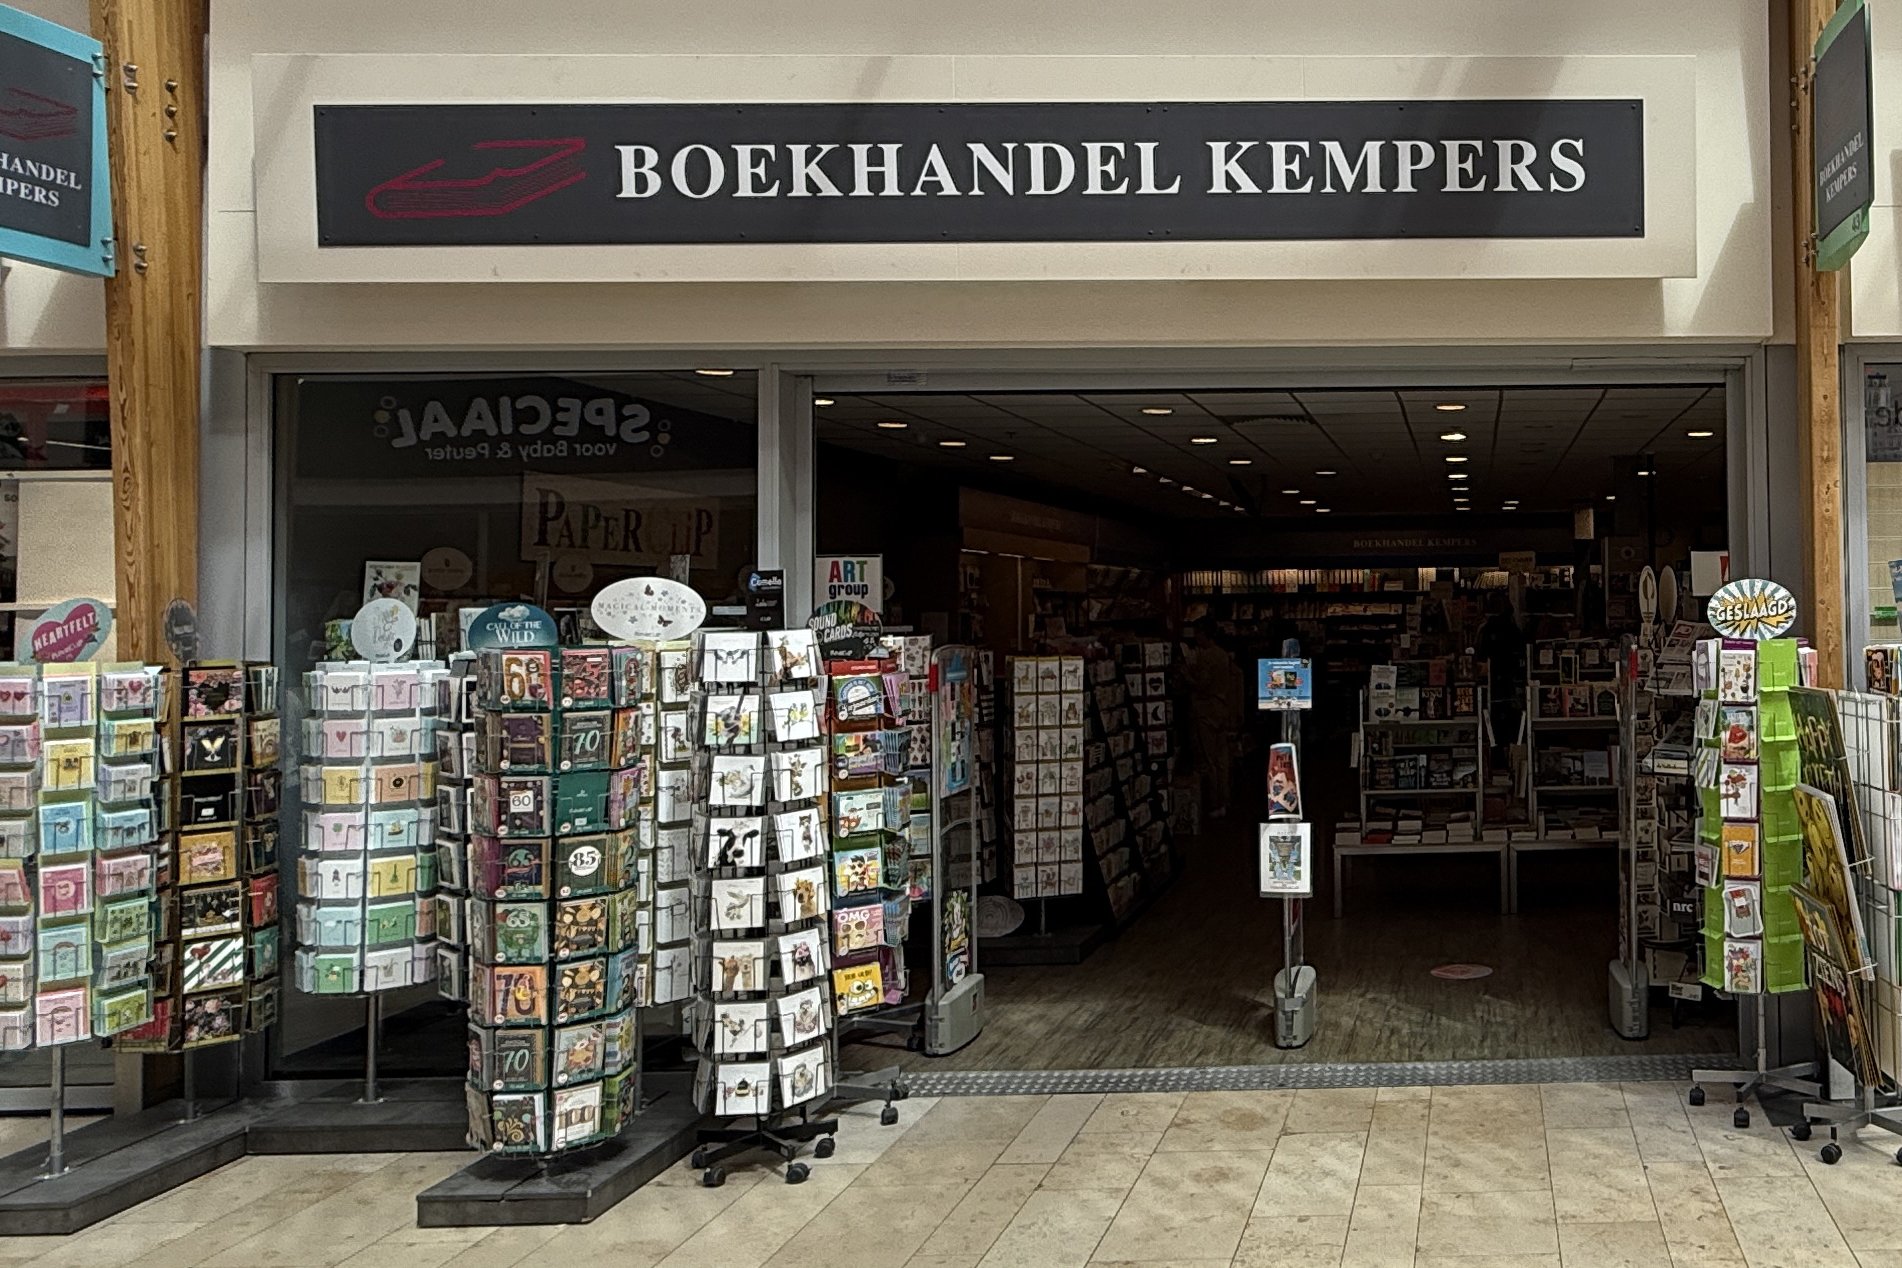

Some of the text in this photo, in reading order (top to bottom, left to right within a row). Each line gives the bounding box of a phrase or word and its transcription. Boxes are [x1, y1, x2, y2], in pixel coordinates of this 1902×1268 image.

[615, 138, 1587, 199] BOEKHANDEL KEMPERS
[829, 560, 868, 583] ART
[828, 584, 869, 600] group
[1715, 600, 1790, 622] GESLAAGD
[33, 611, 95, 651] HEARTFELT
[486, 620, 542, 631] CALL OF THE
[808, 612, 838, 632] SOUND
[496, 627, 535, 643] WILD
[824, 623, 854, 643] CARDS
[574, 729, 600, 755] 70
[837, 909, 870, 923] OMG
[1672, 900, 1693, 913] nrc
